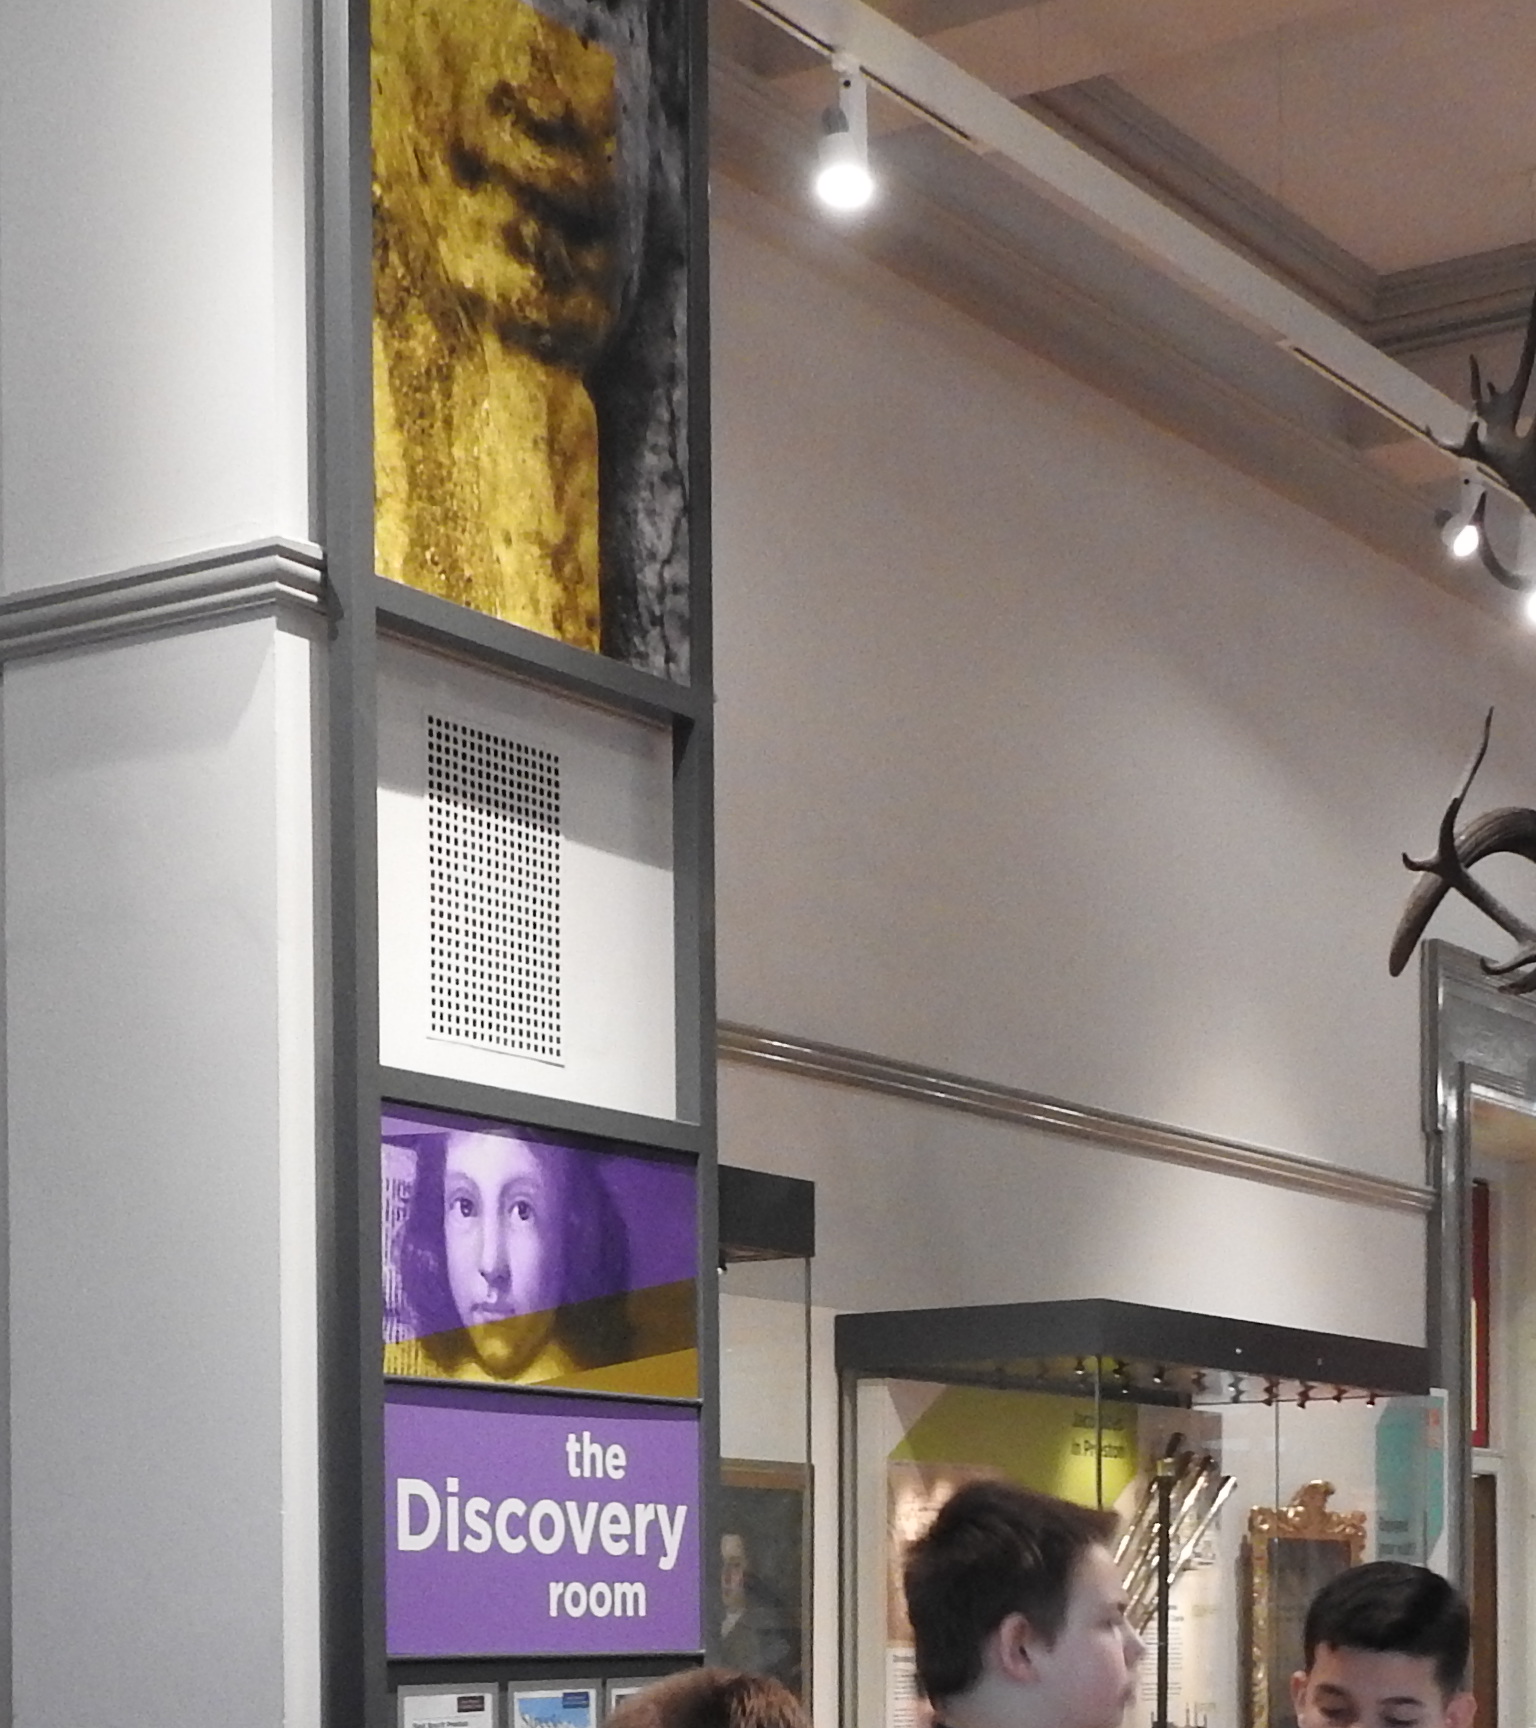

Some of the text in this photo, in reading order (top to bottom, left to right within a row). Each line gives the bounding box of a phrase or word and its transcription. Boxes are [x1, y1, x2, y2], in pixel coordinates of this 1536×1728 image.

[565, 1431, 627, 1480] the
[396, 1476, 688, 1570] Discovery
[548, 1576, 647, 1618] room
